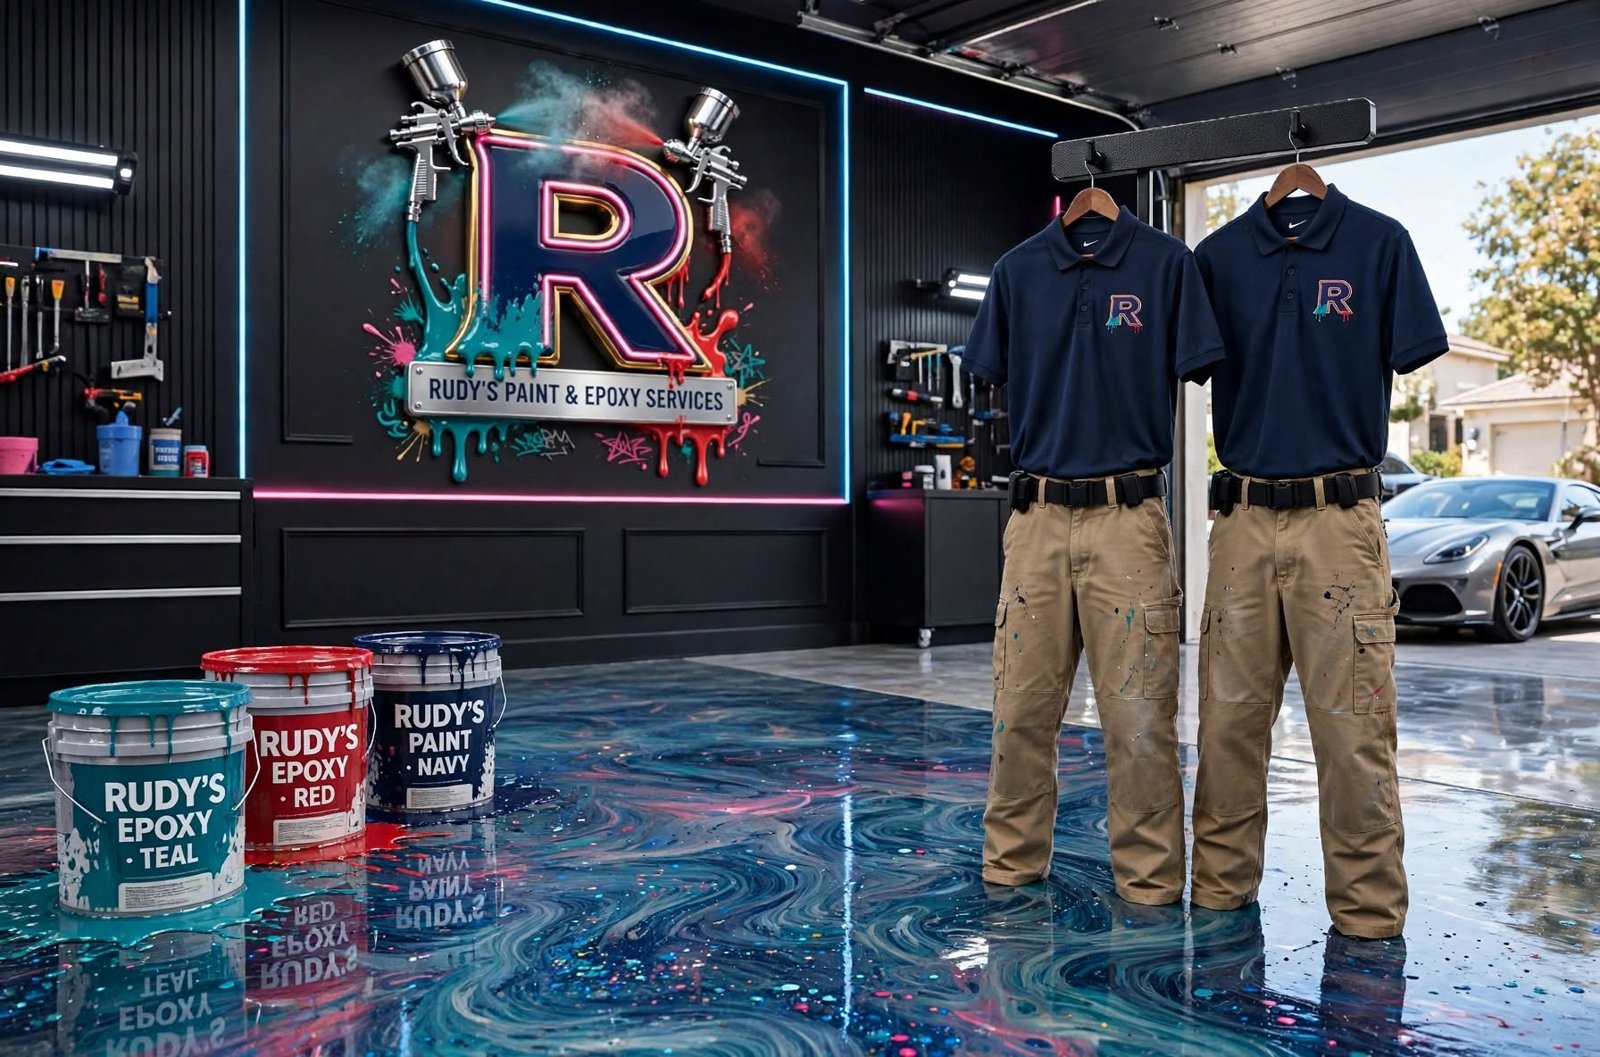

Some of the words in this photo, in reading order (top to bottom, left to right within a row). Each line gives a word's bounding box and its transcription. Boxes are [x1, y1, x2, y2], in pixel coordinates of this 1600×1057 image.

[445, 129, 711, 372] R
[1105, 294, 1143, 328] R
[1313, 279, 1353, 317] R
[429, 378, 498, 402] RUDY'S
[505, 382, 559, 404] PAINT
[565, 385, 578, 405] &
[585, 386, 641, 407] EPOXY
[646, 389, 723, 411] SERVICES
[394, 700, 485, 729] RUDY'S
[260, 724, 359, 757] RUDY'S
[409, 729, 472, 753] PAINT
[272, 755, 348, 784] EPOXY
[418, 754, 470, 776] NAVY
[105, 772, 226, 812] RUDY'S
[294, 785, 335, 808] RED
[118, 809, 213, 843] EPOXY
[140, 843, 199, 870] TEAL
